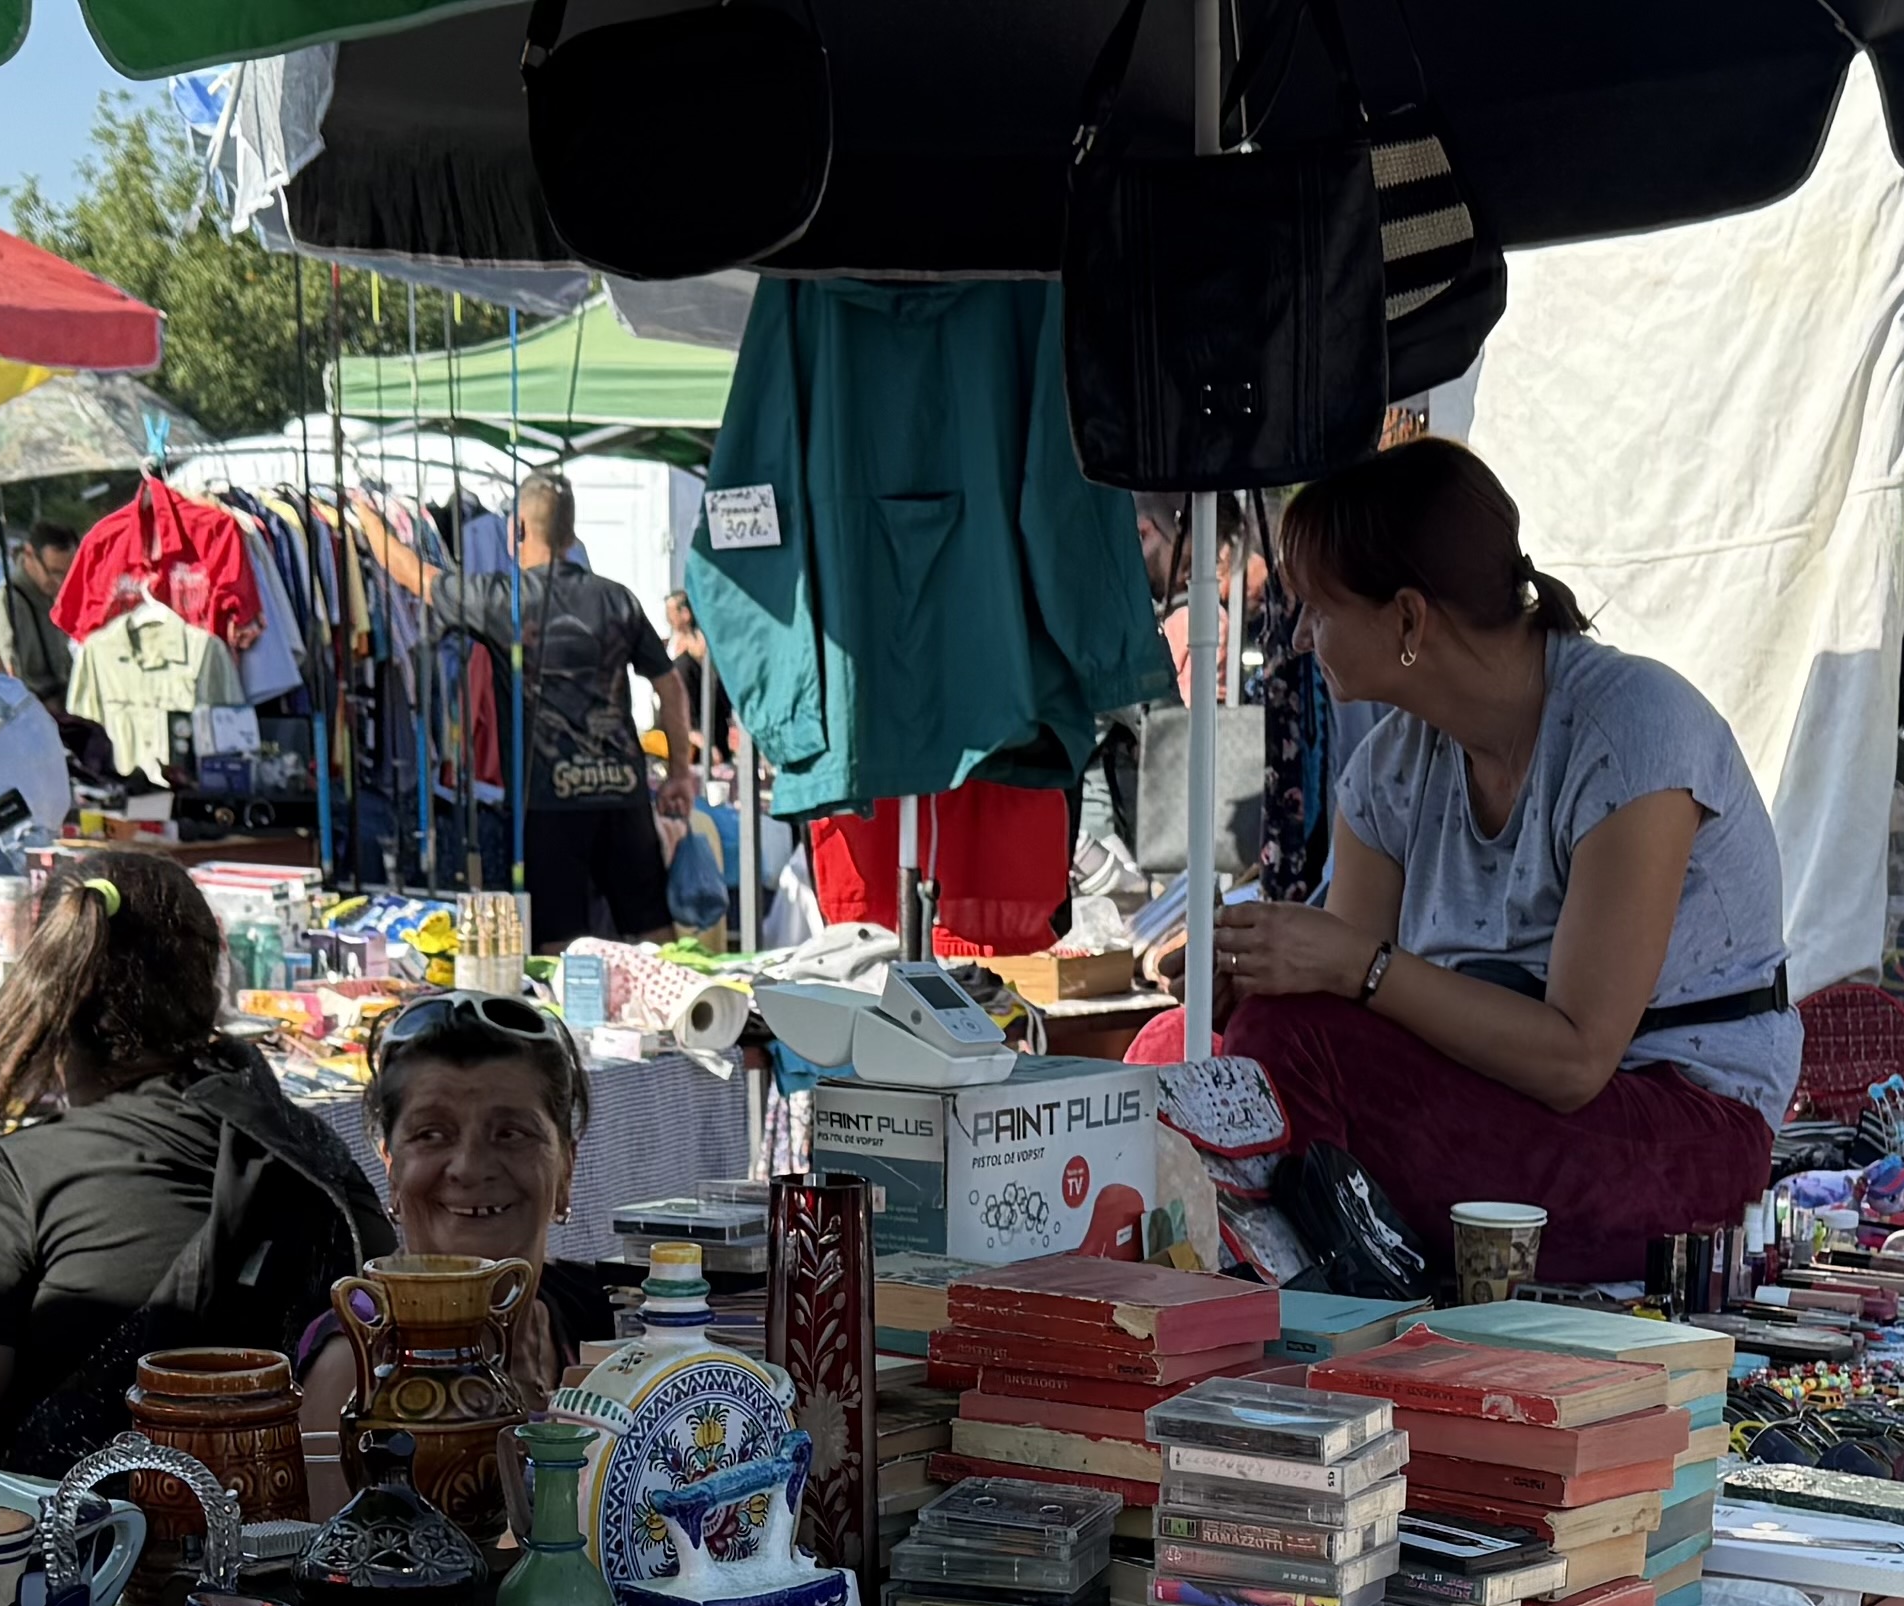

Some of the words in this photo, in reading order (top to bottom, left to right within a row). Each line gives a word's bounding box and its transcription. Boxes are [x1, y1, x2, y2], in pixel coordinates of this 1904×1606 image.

[815, 1109, 873, 1133] PAINT
[877, 1114, 934, 1137] PLUS
[972, 1101, 1061, 1147] PAINT
[1067, 1089, 1141, 1133] PLUS
[817, 1131, 844, 1145] PISTOL
[972, 1152, 1002, 1170] PISTOL
[1004, 1152, 1015, 1165] DE
[1017, 1147, 1045, 1164] VOPSIT
[1067, 1175, 1084, 1197] TV
[1202, 1531, 1283, 1551] RAMAZZOTTI
